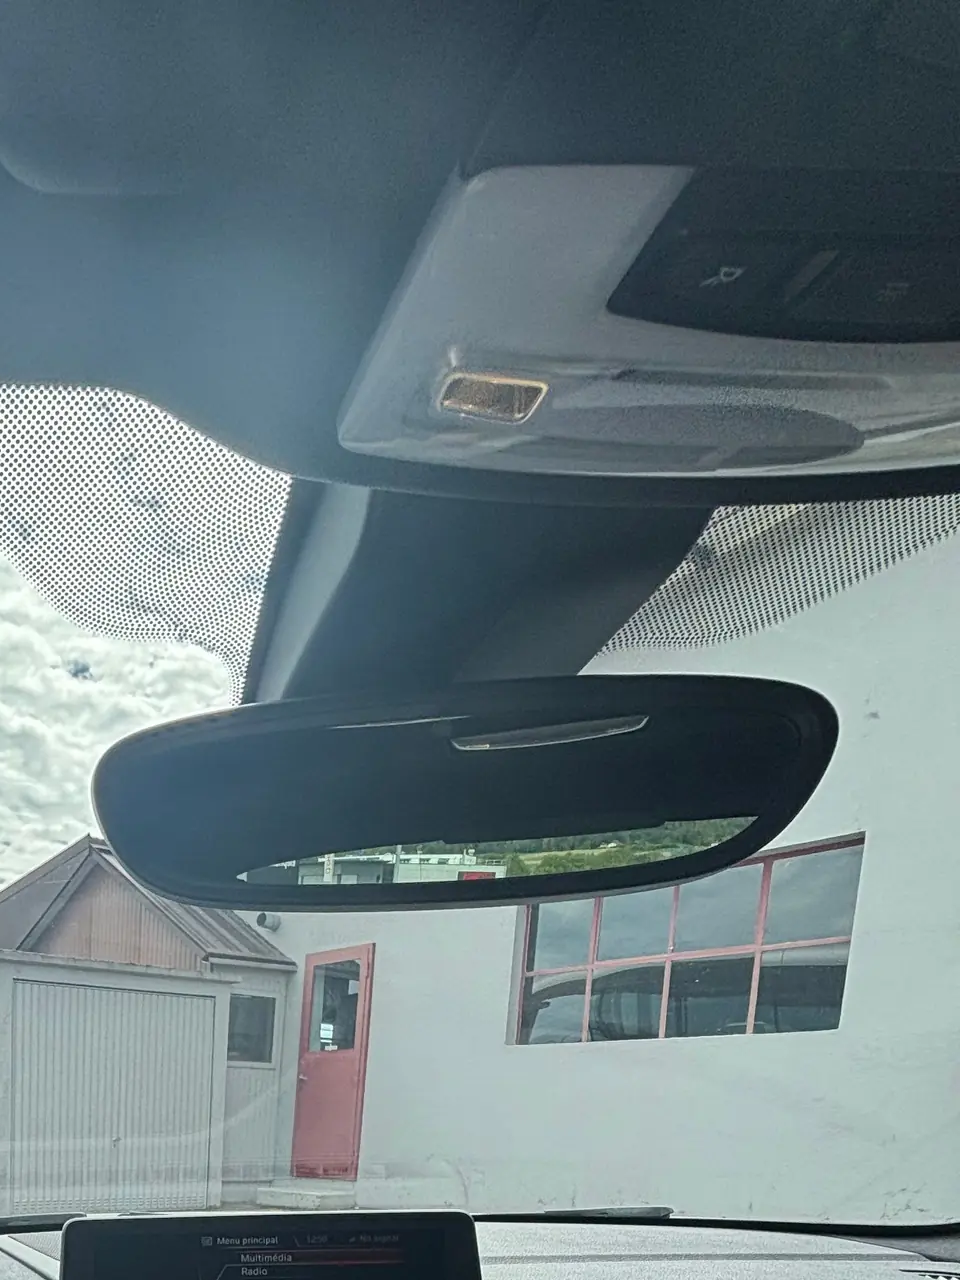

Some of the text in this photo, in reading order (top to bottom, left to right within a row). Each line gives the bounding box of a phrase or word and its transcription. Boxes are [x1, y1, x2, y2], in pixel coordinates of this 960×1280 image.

[217, 1236, 279, 1246] Menu principal
[241, 1253, 292, 1262] Multimédia
[241, 1267, 268, 1276] Radio
